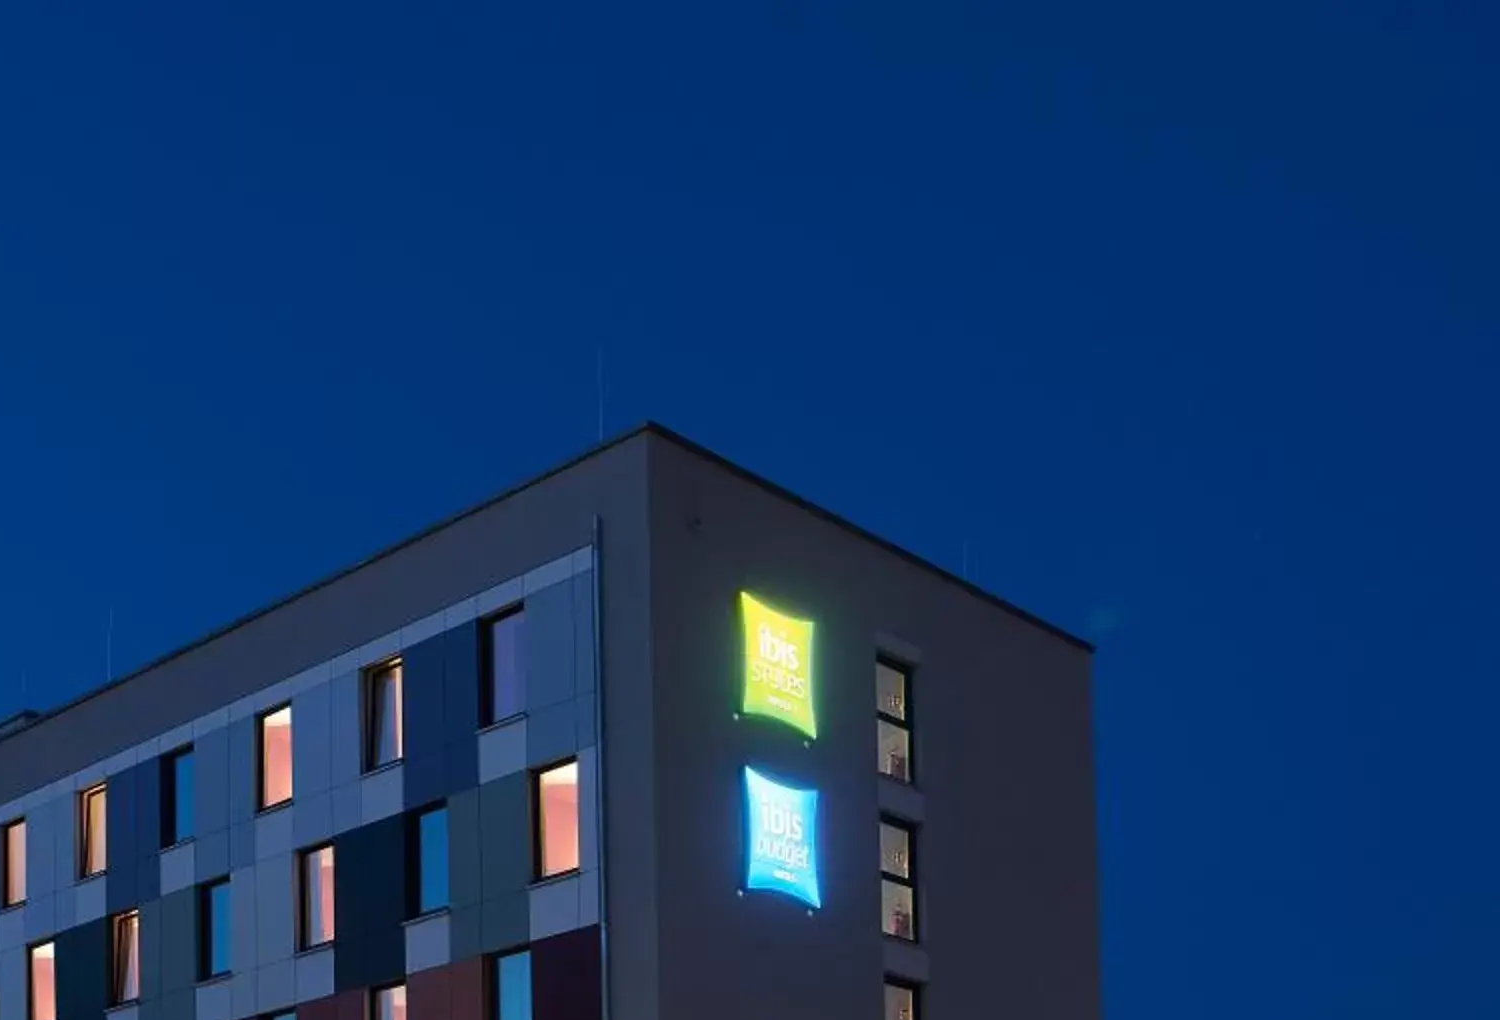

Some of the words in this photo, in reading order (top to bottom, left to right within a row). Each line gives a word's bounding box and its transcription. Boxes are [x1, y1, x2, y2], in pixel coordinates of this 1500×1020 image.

[758, 625, 799, 671] ibis
[761, 793, 803, 840] ibis
[757, 833, 809, 869] budget
